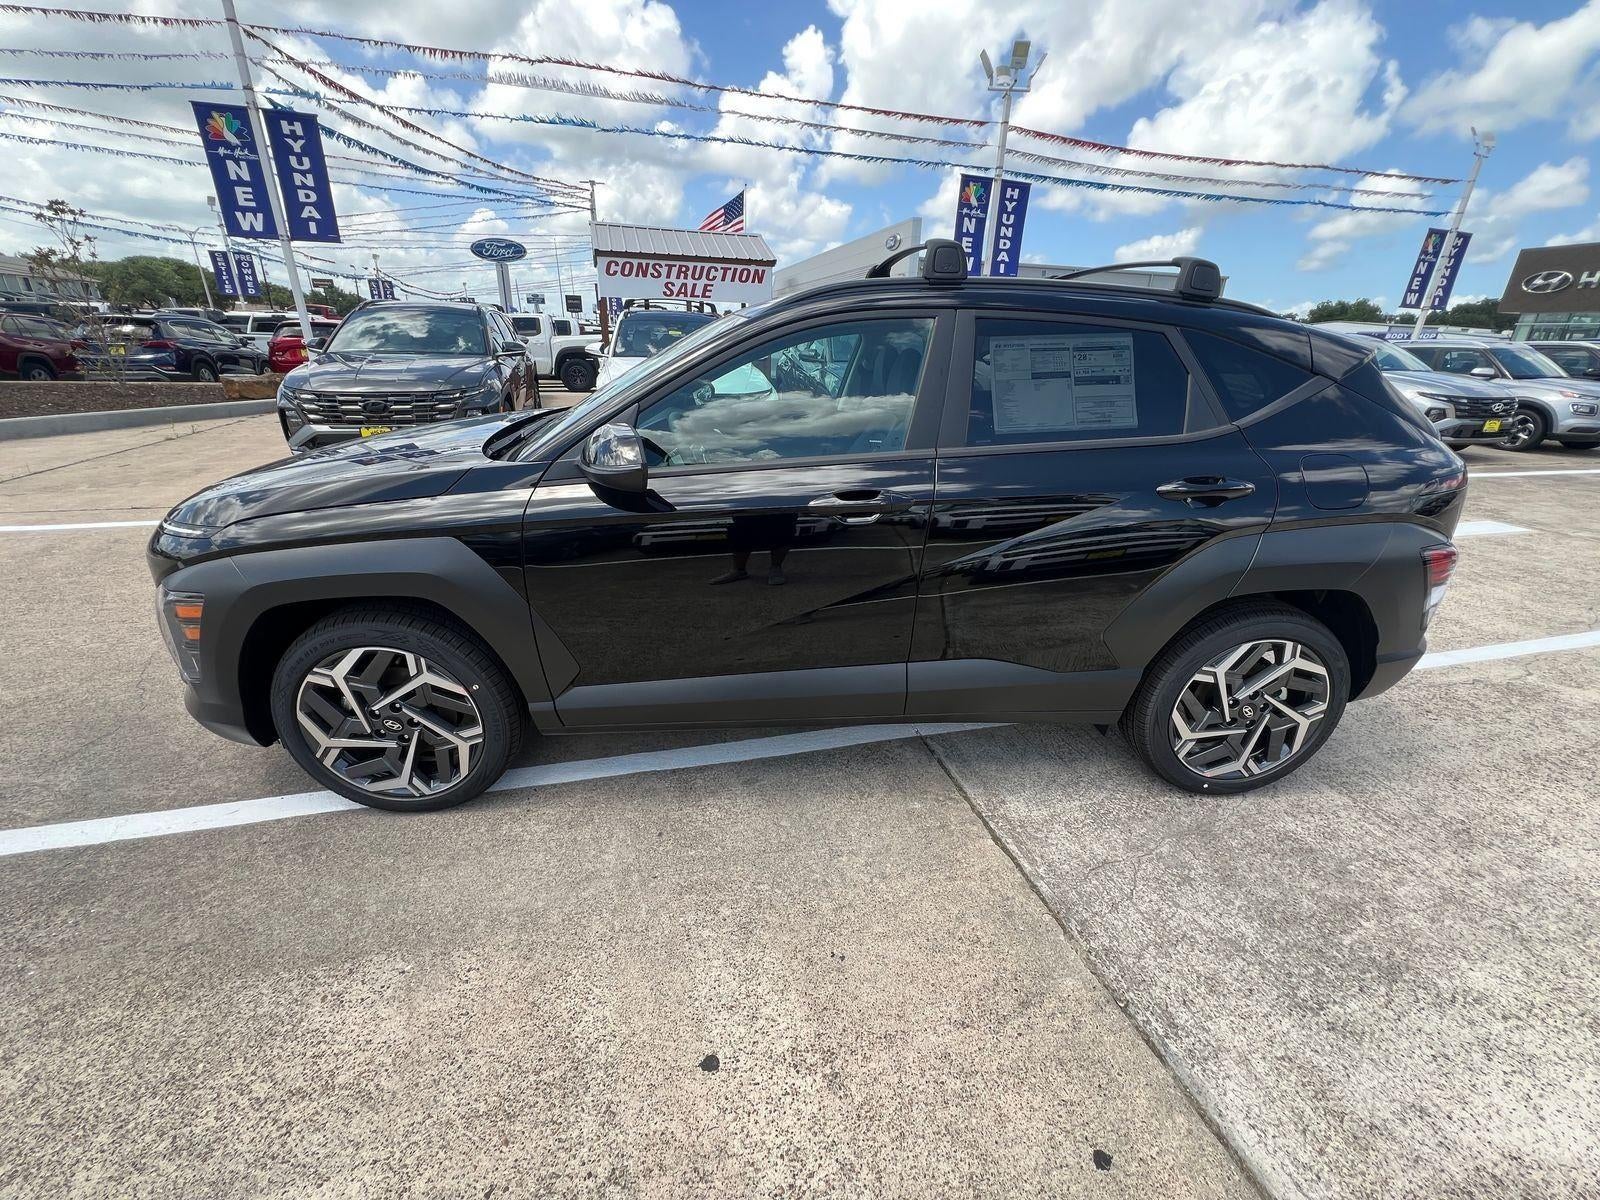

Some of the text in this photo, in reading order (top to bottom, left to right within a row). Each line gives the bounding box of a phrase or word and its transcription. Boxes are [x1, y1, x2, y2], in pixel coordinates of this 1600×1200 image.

[226, 160, 263, 231] NEW
[280, 120, 321, 234] HYUNDAI
[997, 187, 1019, 273] HYUNDAI
[234, 253, 252, 261] PRE
[483, 242, 514, 256] Ford
[215, 252, 233, 294] CERTIFIED
[241, 261, 255, 294] OWNED
[605, 260, 766, 284] CONSTRUCTION
[663, 281, 714, 298] SALE
[1406, 262, 1428, 304] NEW
